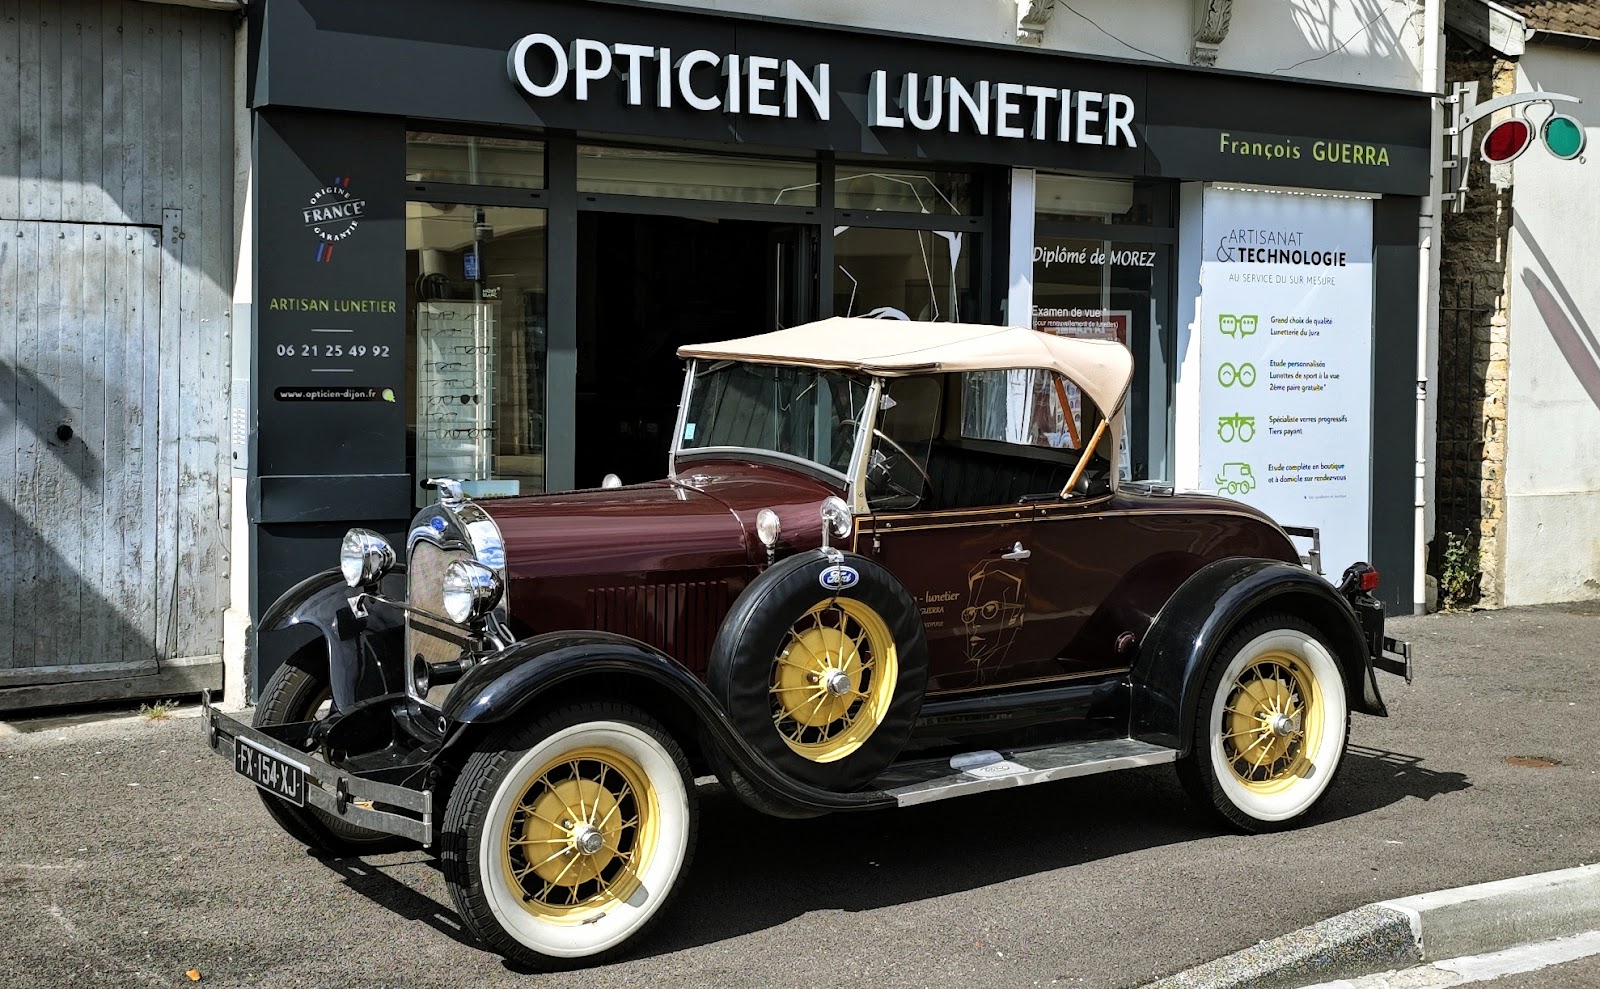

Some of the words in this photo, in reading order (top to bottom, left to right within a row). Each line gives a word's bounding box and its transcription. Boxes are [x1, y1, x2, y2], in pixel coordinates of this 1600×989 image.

[508, 32, 831, 121] OPTICIEN
[868, 69, 1138, 149] LUNETIER
[1219, 132, 1301, 160] François
[1312, 140, 1390, 166] GUERRA
[310, 186, 351, 205] ORIGINE
[314, 219, 359, 241] GARANTIE
[1229, 229, 1304, 247] ARTISANAT
[1033, 246, 1086, 268] Diplômé
[1090, 248, 1107, 265] de
[1110, 251, 1156, 267] MOREZ
[1238, 247, 1347, 267] TECHNOLOGIE
[1229, 273, 1240, 283] AU
[1242, 274, 1273, 284] SERVICE
[1275, 275, 1287, 284] DU
[1289, 275, 1304, 285] SUR
[1306, 276, 1336, 286] MESURE
[269, 298, 329, 312] ARTISAN
[334, 299, 396, 313] LUNETIER
[1032, 305, 1069, 317] Examen
[1070, 307, 1083, 318] de
[1313, 317, 1332, 326] qualité
[1270, 328, 1299, 336] Lunetterie
[1300, 328, 1308, 336] du
[276, 344, 295, 357] 06
[301, 345, 318, 357] 21
[325, 345, 343, 357] 25
[348, 345, 367, 357] 49
[372, 346, 390, 358] 92
[1303, 372, 1317, 381] sport
[1287, 384, 1300, 392] paire
[279, 389, 377, 401] www.opticien-dijon.fr
[1269, 415, 1298, 424] Spécialiste
[1318, 415, 1347, 424] progressifs
[1284, 428, 1302, 436] payant
[1321, 462, 1345, 471] boutique
[1280, 475, 1303, 483] domicile
[1314, 474, 1346, 482] rendez-vous
[827, 570, 852, 584] Ford
[925, 590, 960, 603] lunetier
